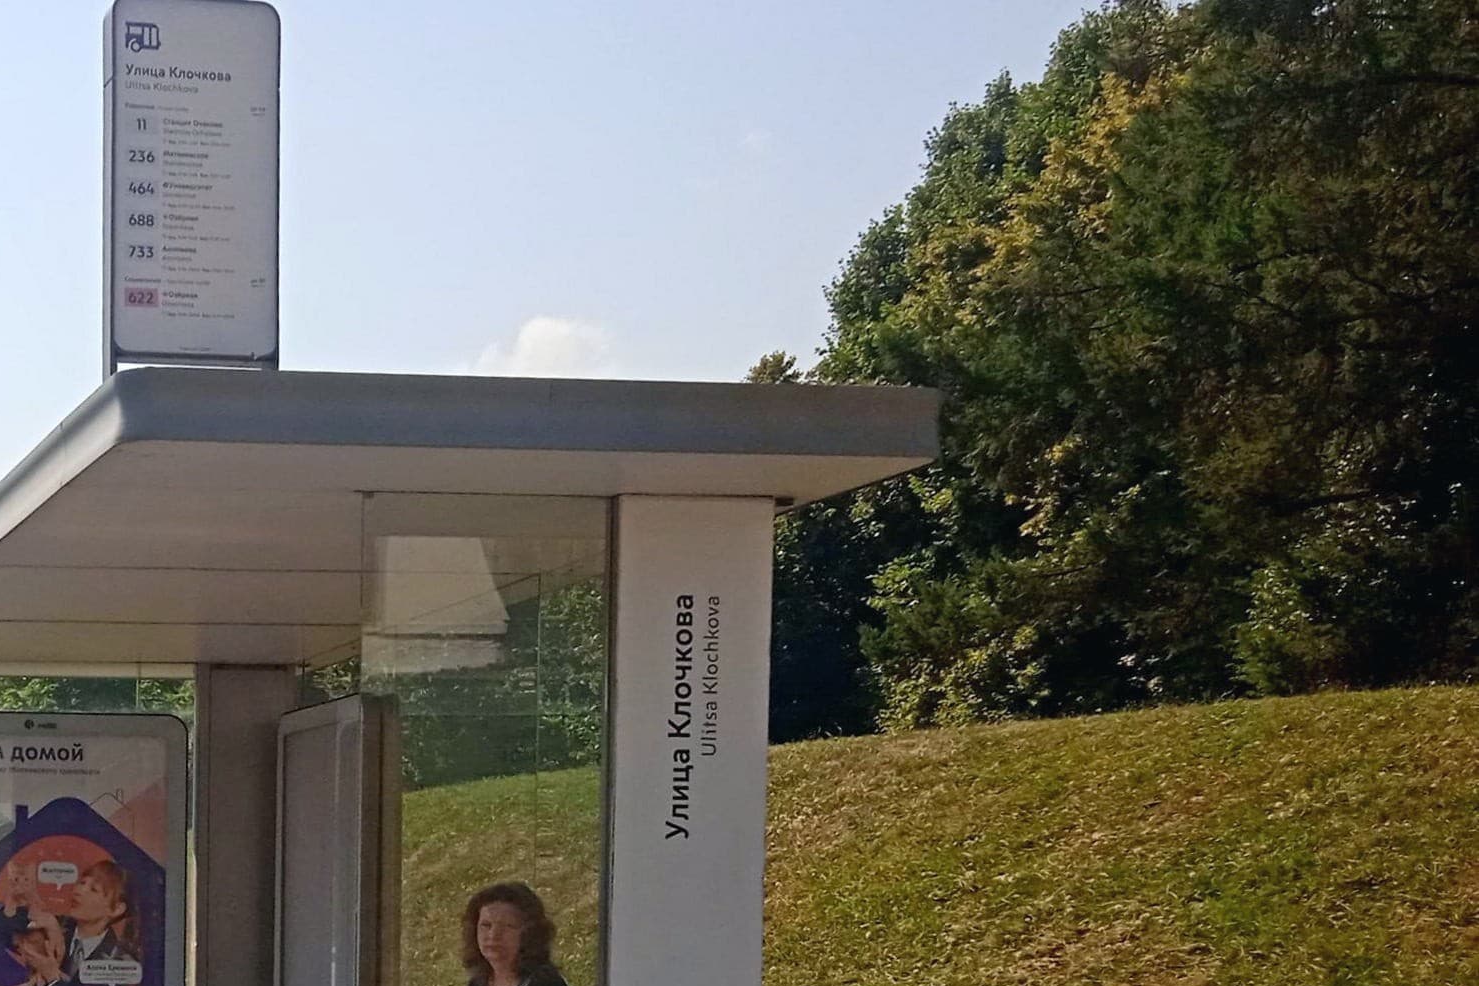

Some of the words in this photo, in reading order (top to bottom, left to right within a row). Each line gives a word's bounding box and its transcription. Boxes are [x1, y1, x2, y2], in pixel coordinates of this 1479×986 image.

[125, 64, 166, 78] Улица
[169, 66, 232, 82] Клочкова
[136, 118, 147, 131] 11
[128, 150, 155, 163] 236
[128, 181, 155, 195] 464
[128, 214, 155, 226] 688
[128, 245, 154, 259] 733
[128, 291, 154, 305] 622
[702, 595, 720, 695] Klochkova
[668, 594, 694, 738] Клочкова
[701, 701, 718, 756] Ulitsa
[11, 742, 84, 763] домой
[665, 748, 694, 839] Улица
